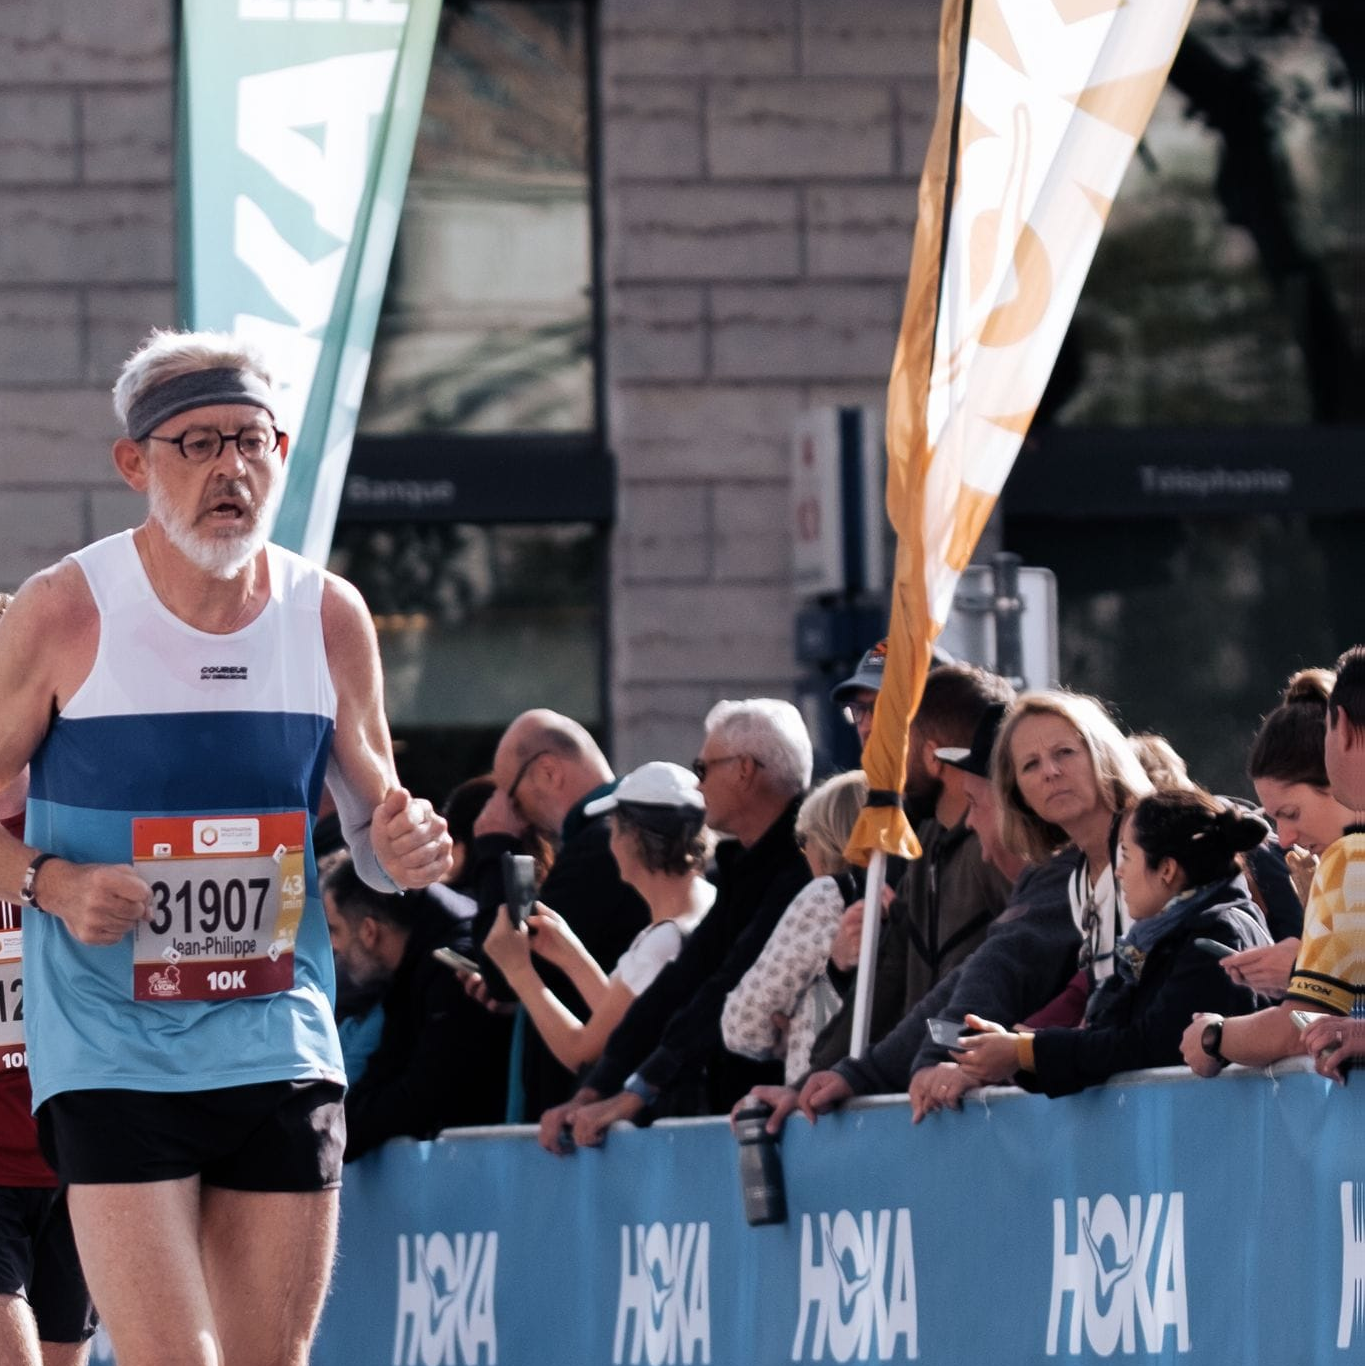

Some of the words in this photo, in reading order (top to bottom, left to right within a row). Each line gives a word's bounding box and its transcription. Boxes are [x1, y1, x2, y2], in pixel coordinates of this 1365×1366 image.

[348, 474, 455, 507] Banque
[149, 877, 271, 935] 31907
[281, 875, 304, 895] 43
[171, 937, 257, 959] Jean-Philippe
[206, 969, 247, 991] 10K
[1296, 981, 1333, 996] LYON
[792, 1208, 919, 1363] HOKA
[1046, 1192, 1191, 1357] HOKA
